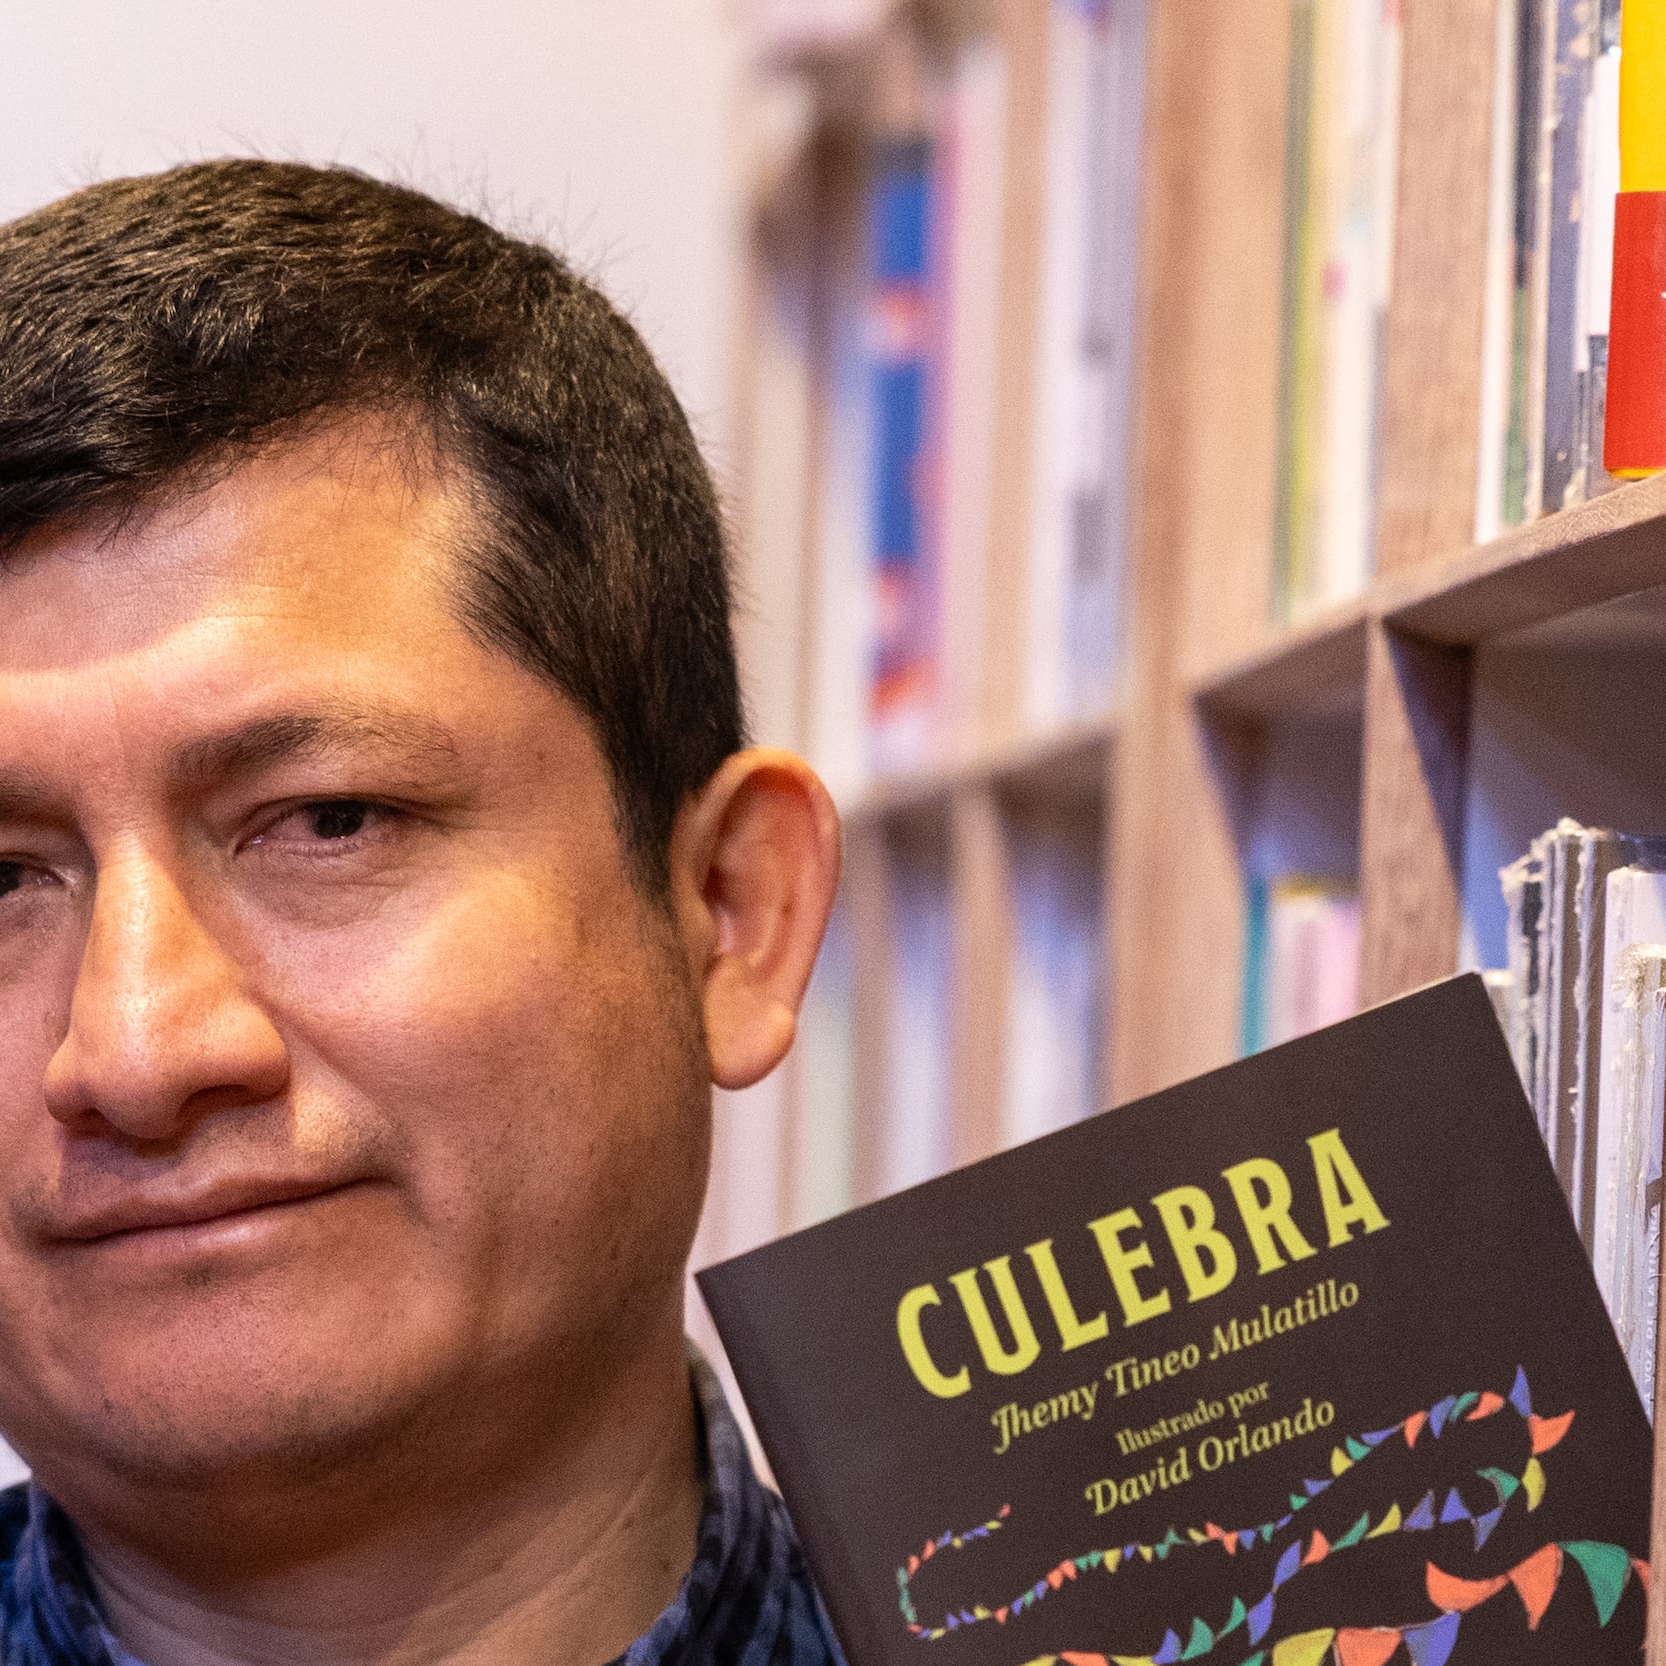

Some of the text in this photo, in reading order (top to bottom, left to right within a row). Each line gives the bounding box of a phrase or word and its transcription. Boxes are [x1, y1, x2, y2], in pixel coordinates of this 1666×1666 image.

[896, 1127, 1391, 1399] CULEBRA
[1647, 1283, 1655, 1308] LA
[990, 1278, 1360, 1456] Jhemy Tineo Mulatillo
[1115, 1382, 1270, 1456] Ilustrado por
[1084, 1397, 1335, 1516] David Orlando
